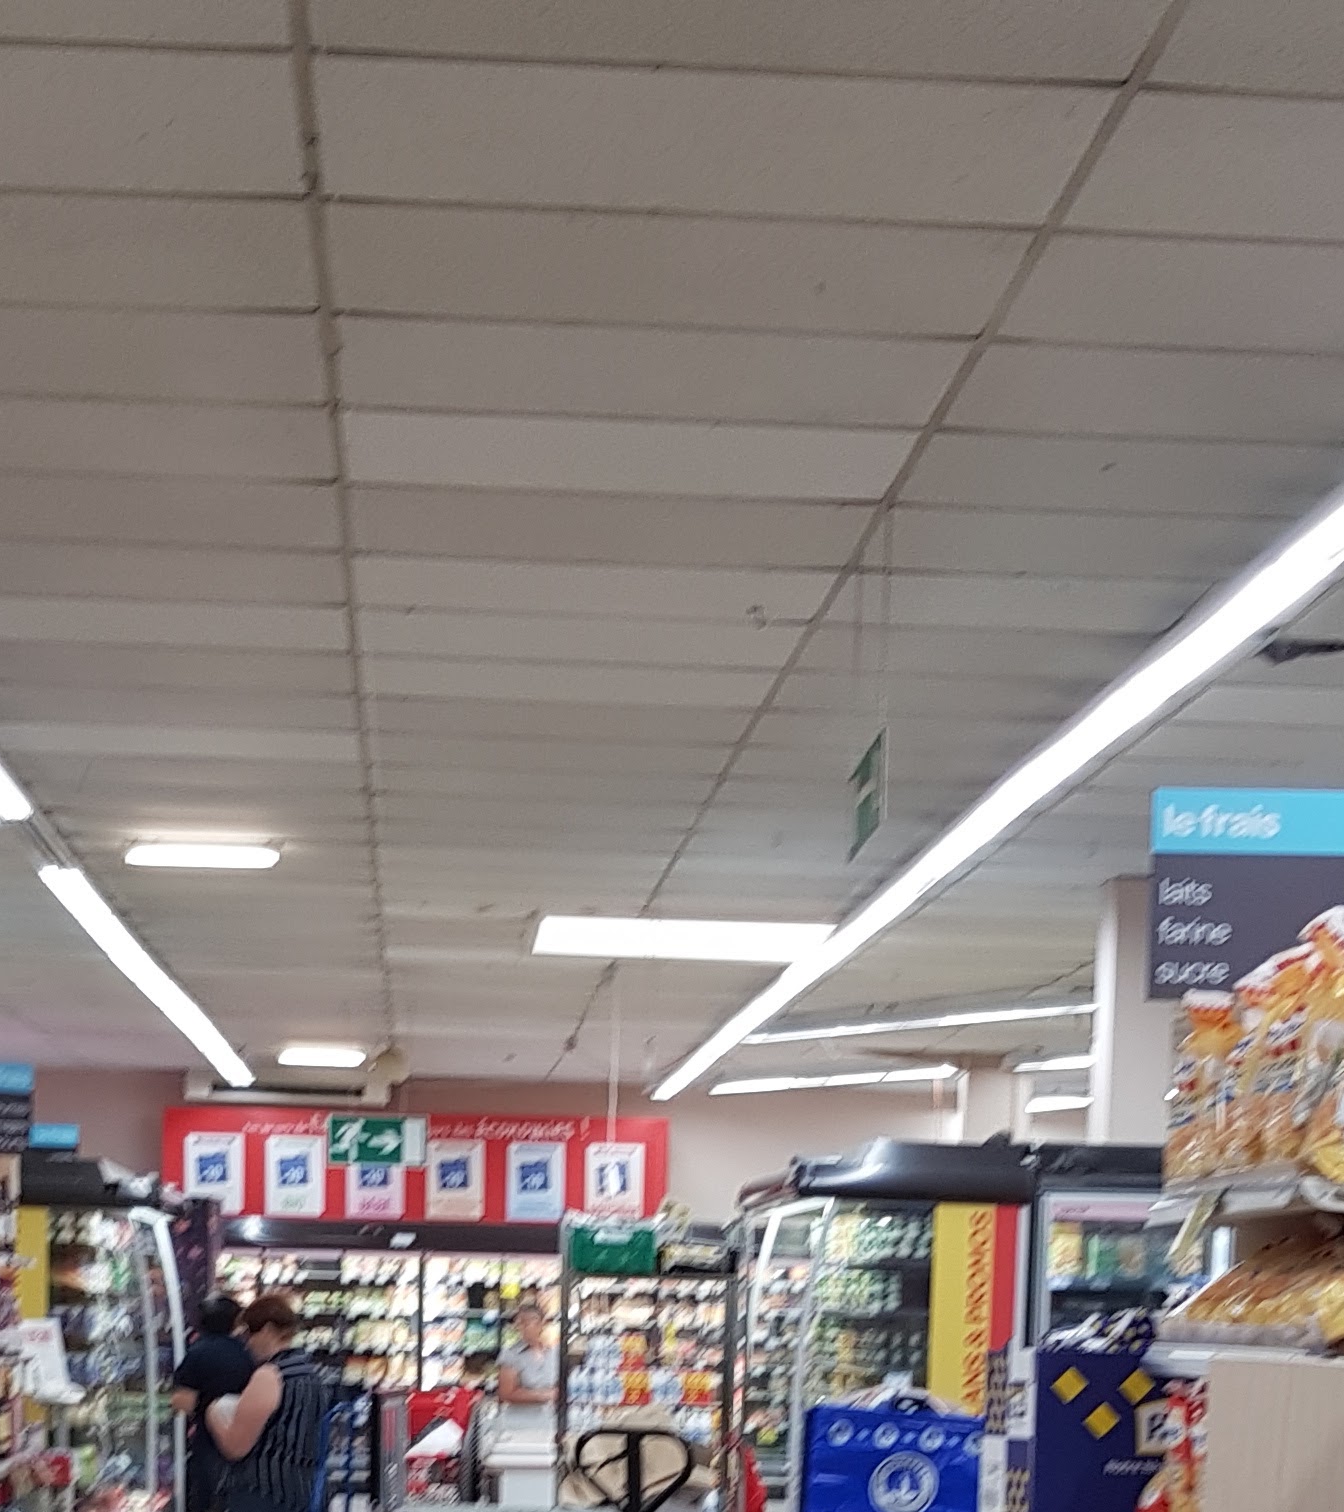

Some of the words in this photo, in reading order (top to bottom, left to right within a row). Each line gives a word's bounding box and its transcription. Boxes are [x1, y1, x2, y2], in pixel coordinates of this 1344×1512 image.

[1161, 803, 1197, 839] le
[1200, 803, 1281, 840] frais
[1156, 916, 1233, 947] farine
[1154, 961, 1231, 986] sucre
[964, 1210, 992, 1326] PROMOS
